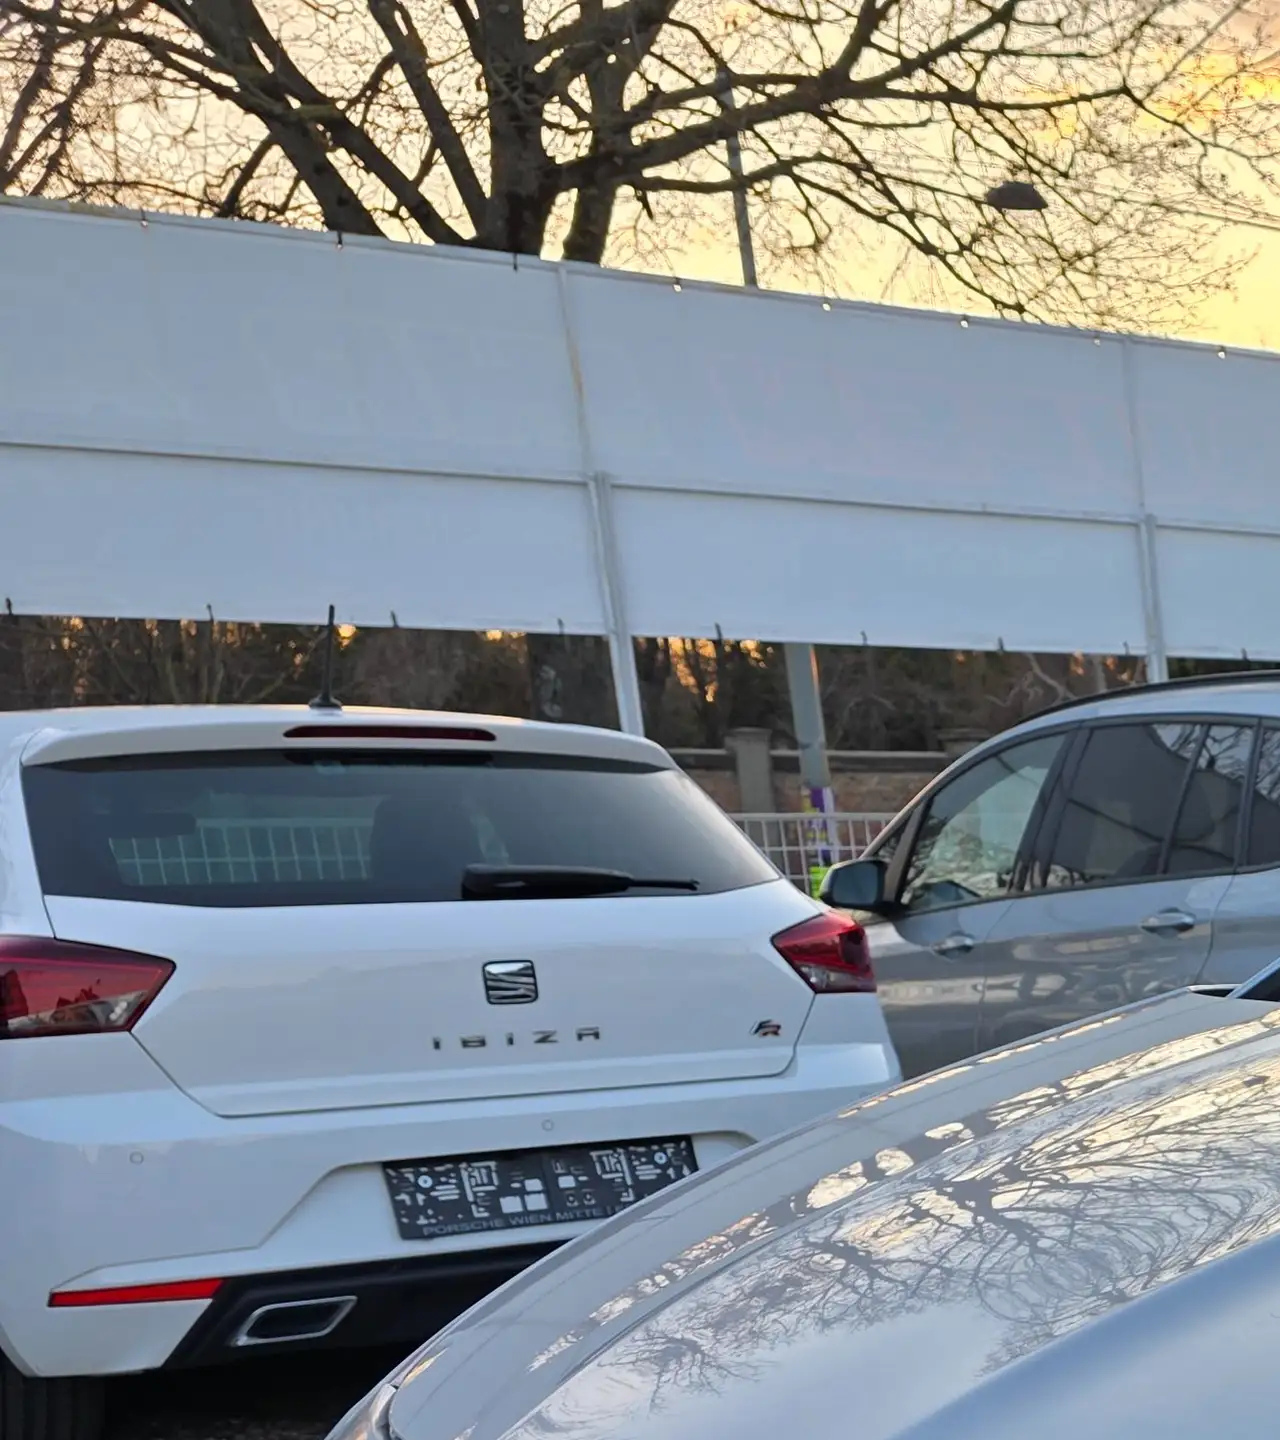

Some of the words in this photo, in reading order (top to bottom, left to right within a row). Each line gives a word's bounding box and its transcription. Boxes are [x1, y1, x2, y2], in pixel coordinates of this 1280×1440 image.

[432, 1026, 601, 1050] IBIZA
[423, 1217, 504, 1237] PORSCHE
[509, 1213, 551, 1227] WIEN
[555, 1208, 603, 1221] MITTE
